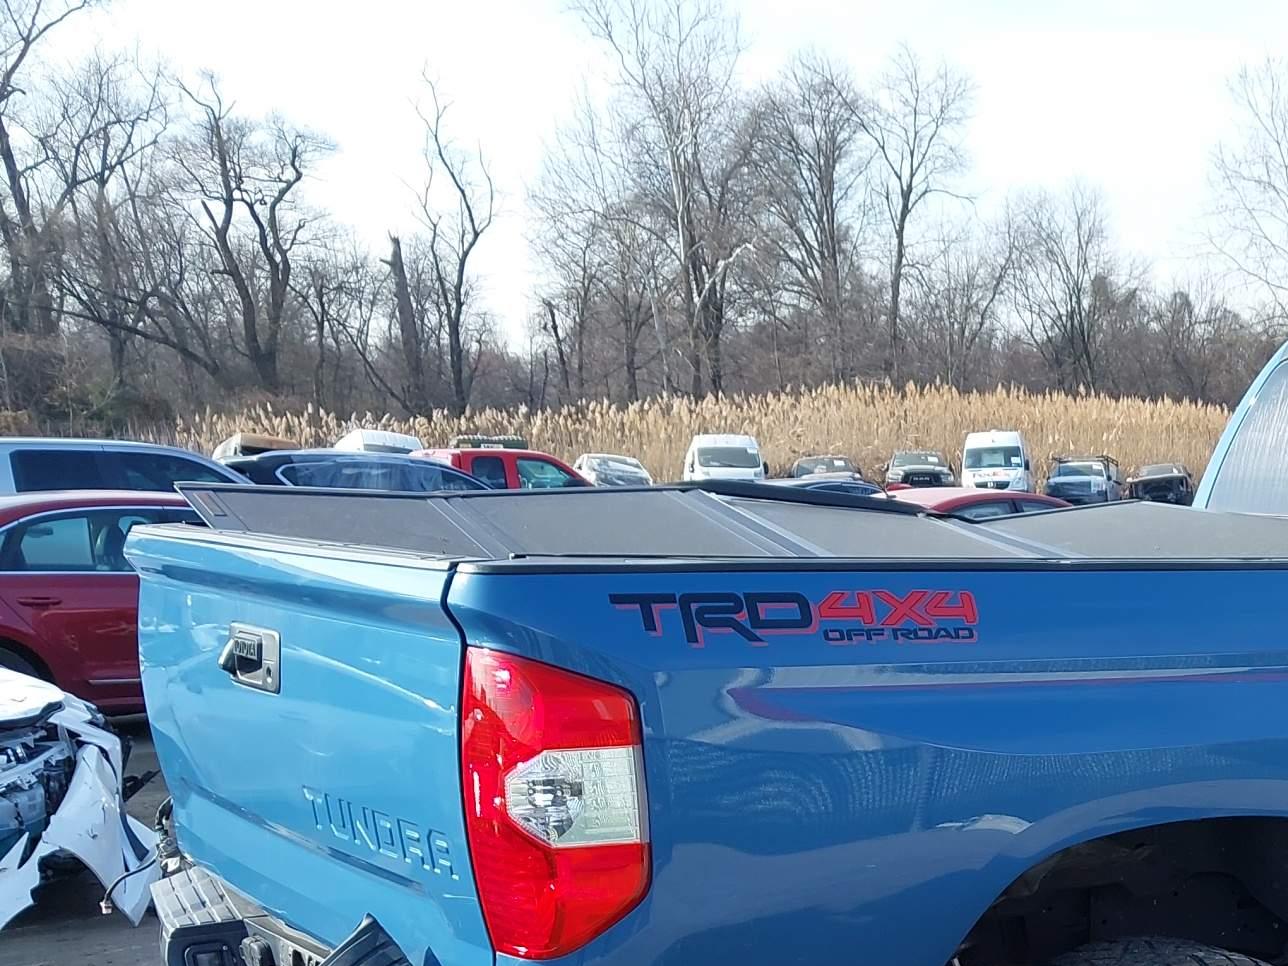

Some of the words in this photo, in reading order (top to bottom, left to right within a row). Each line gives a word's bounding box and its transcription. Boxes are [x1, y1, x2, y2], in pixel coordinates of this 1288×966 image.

[608, 591, 816, 646] TRD
[818, 590, 978, 627] 4X4
[823, 628, 886, 643] OFF
[891, 627, 976, 643] ROAD
[302, 785, 459, 880] TUNDRA
